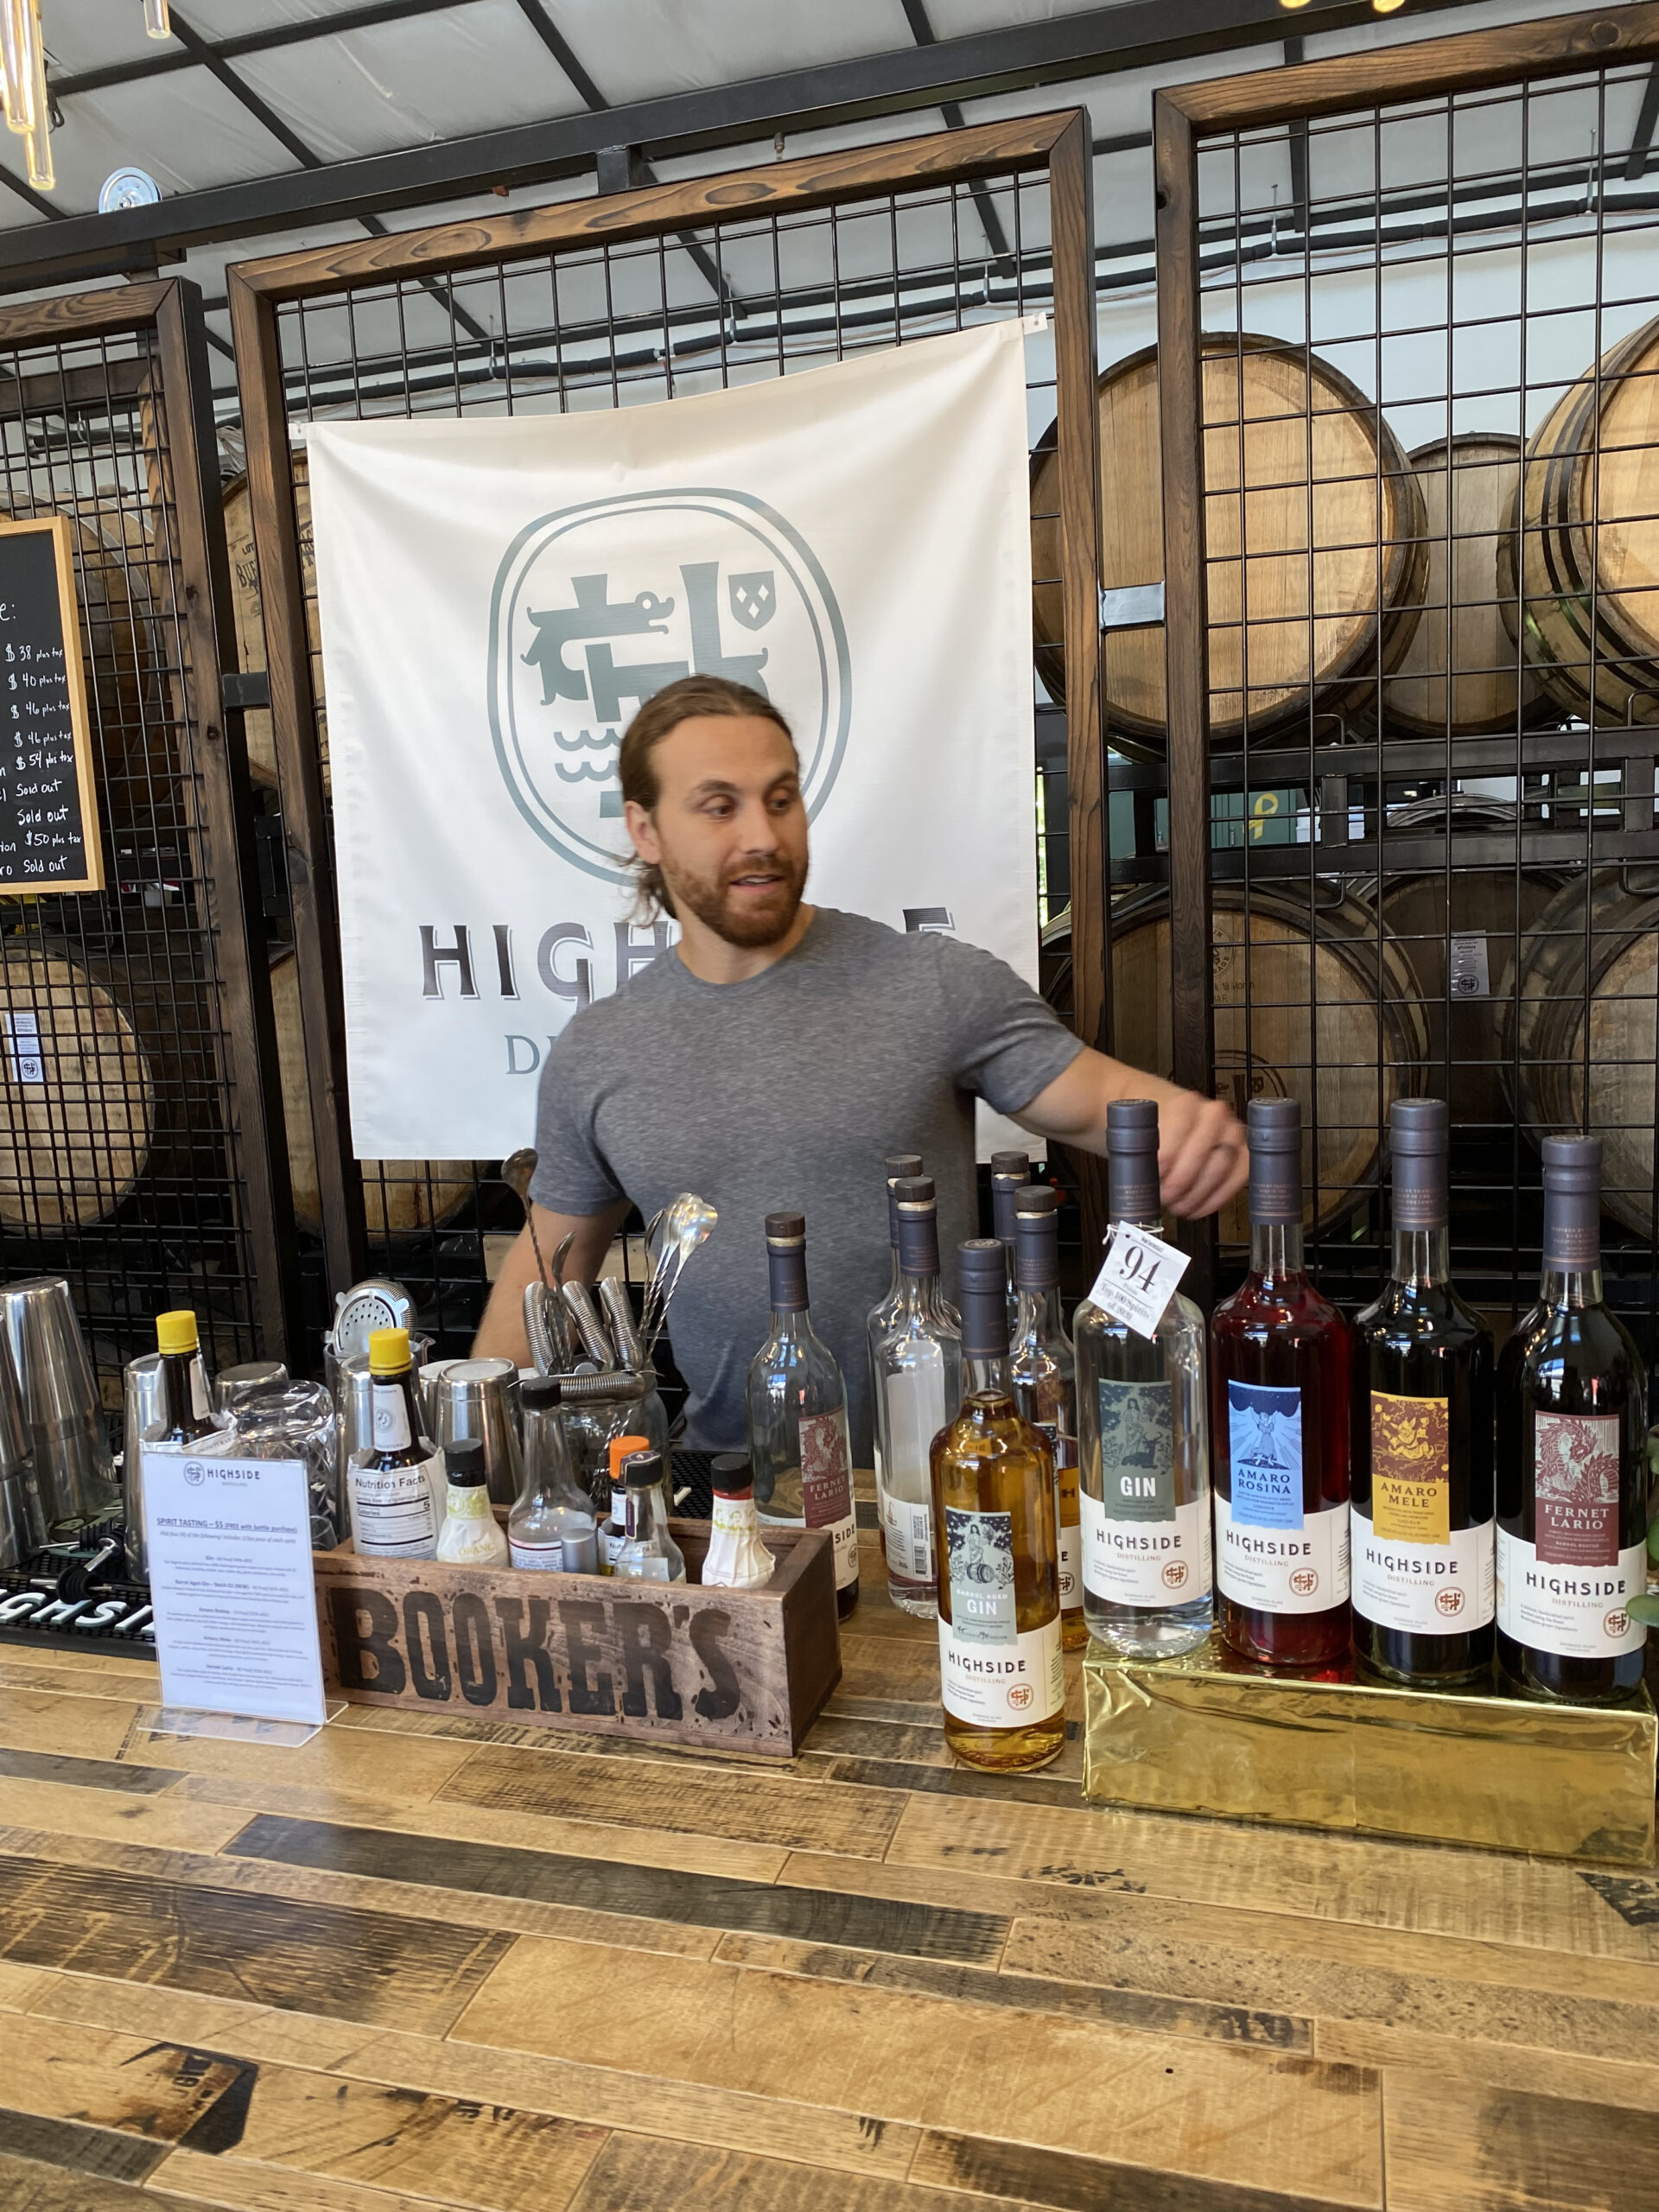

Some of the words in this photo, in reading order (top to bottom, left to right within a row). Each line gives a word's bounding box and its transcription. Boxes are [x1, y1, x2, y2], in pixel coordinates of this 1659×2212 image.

[52, 648, 63, 658] tax
[54, 673, 66, 683] tax
[42, 703, 56, 717] plus
[57, 701, 70, 710] tax
[43, 734, 57, 747] plus
[59, 730, 71, 741] tax
[46, 752, 57, 768] plus
[60, 750, 73, 763] tax
[16, 783, 38, 797] Sold
[41, 779, 63, 793] out
[17, 808, 41, 826] Sold
[47, 804, 69, 822] out
[52, 834, 65, 847] plus
[67, 831, 81, 844] tax
[23, 859, 44, 874] Sold
[48, 855, 68, 873] out
[1119, 1245, 1161, 1294] 94
[207, 1468, 261, 1480] HIGHSIDE
[1238, 1468, 1290, 1484] AMARO
[355, 1478, 396, 1490] Nutrition
[810, 1476, 846, 1493] FERNET
[1120, 1476, 1156, 1497] GIN
[1238, 1478, 1291, 1494] ROSINA
[1381, 1482, 1437, 1497] AMARO
[814, 1485, 844, 1501] LARIO
[423, 1500, 430, 1510] 5
[1389, 1495, 1429, 1508] MELE
[1545, 1504, 1609, 1518] FERNET
[156, 1517, 177, 1527] SPIRIT
[179, 1518, 207, 1528] TASTING
[1551, 1516, 1604, 1529] LARIO
[835, 1523, 855, 1544] SIDE
[1096, 1529, 1182, 1550] HIGHSIDE
[1226, 1529, 1312, 1556] HIGHSIDE
[1116, 1553, 1161, 1561] DISTILLING
[1244, 1555, 1289, 1567] DISTILLING
[1366, 1548, 1459, 1574] HIGHSIDE
[1388, 1574, 1435, 1586] DISTILLING
[1526, 1572, 1626, 1596] HIGHSIDE
[957, 1588, 984, 1599] BARREL
[967, 1599, 996, 1615] GIN
[1552, 1598, 1604, 1608] DISTILLING
[0, 1588, 156, 1635] GHSI
[328, 1586, 742, 1721] BOOKER'S
[949, 1650, 1026, 1674] HIGHSIDE
[965, 1675, 1006, 1684] DISTILLING
